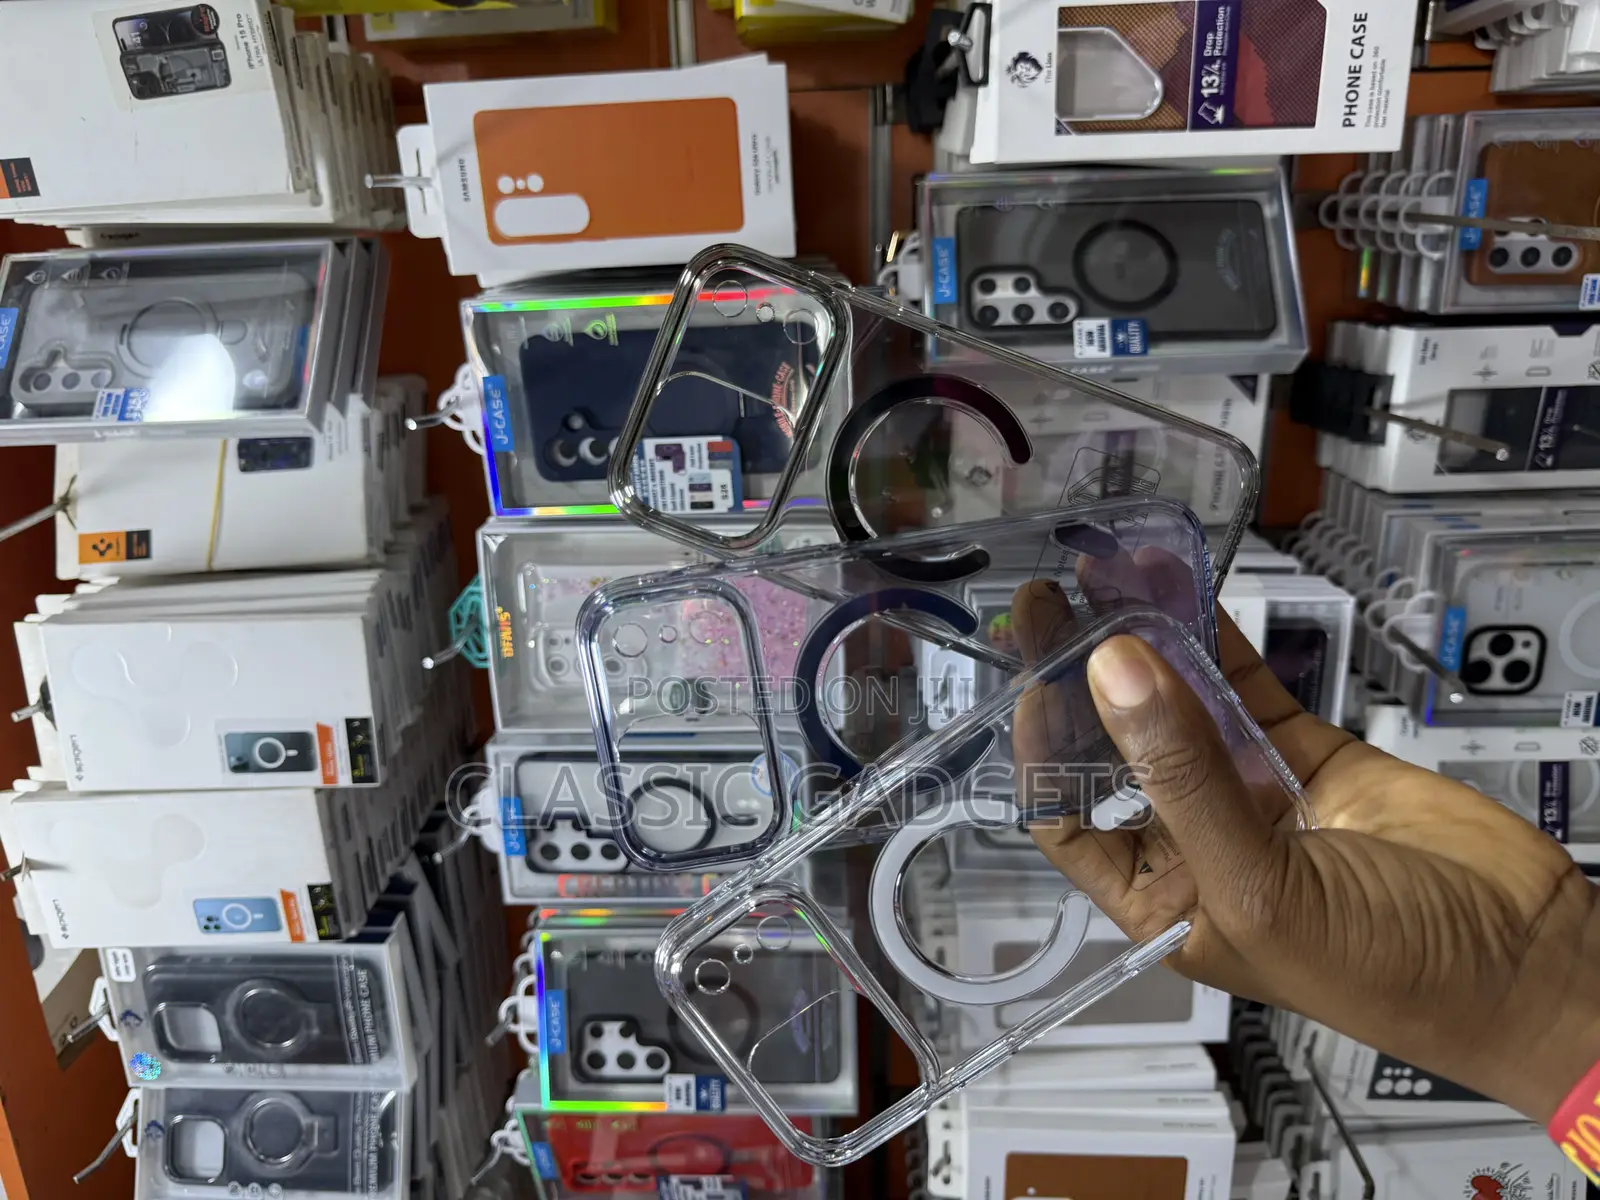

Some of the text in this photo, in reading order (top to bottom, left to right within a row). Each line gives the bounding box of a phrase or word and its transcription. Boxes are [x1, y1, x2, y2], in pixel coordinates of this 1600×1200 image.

[236, 13, 244, 28] Pro
[1203, 32, 1214, 57] Drop
[1213, 6, 1226, 57] Protection
[243, 42, 255, 70] iPhone
[1342, 12, 1368, 128] PHONE CASE
[457, 158, 471, 202] SAMSUNG
[1464, 190, 1481, 244] J-ASE
[937, 247, 951, 298] J-CASE
[1127, 322, 1141, 354] QUALITY
[489, 386, 508, 445] J-CASE
[550, 999, 562, 1048] J-CASE
